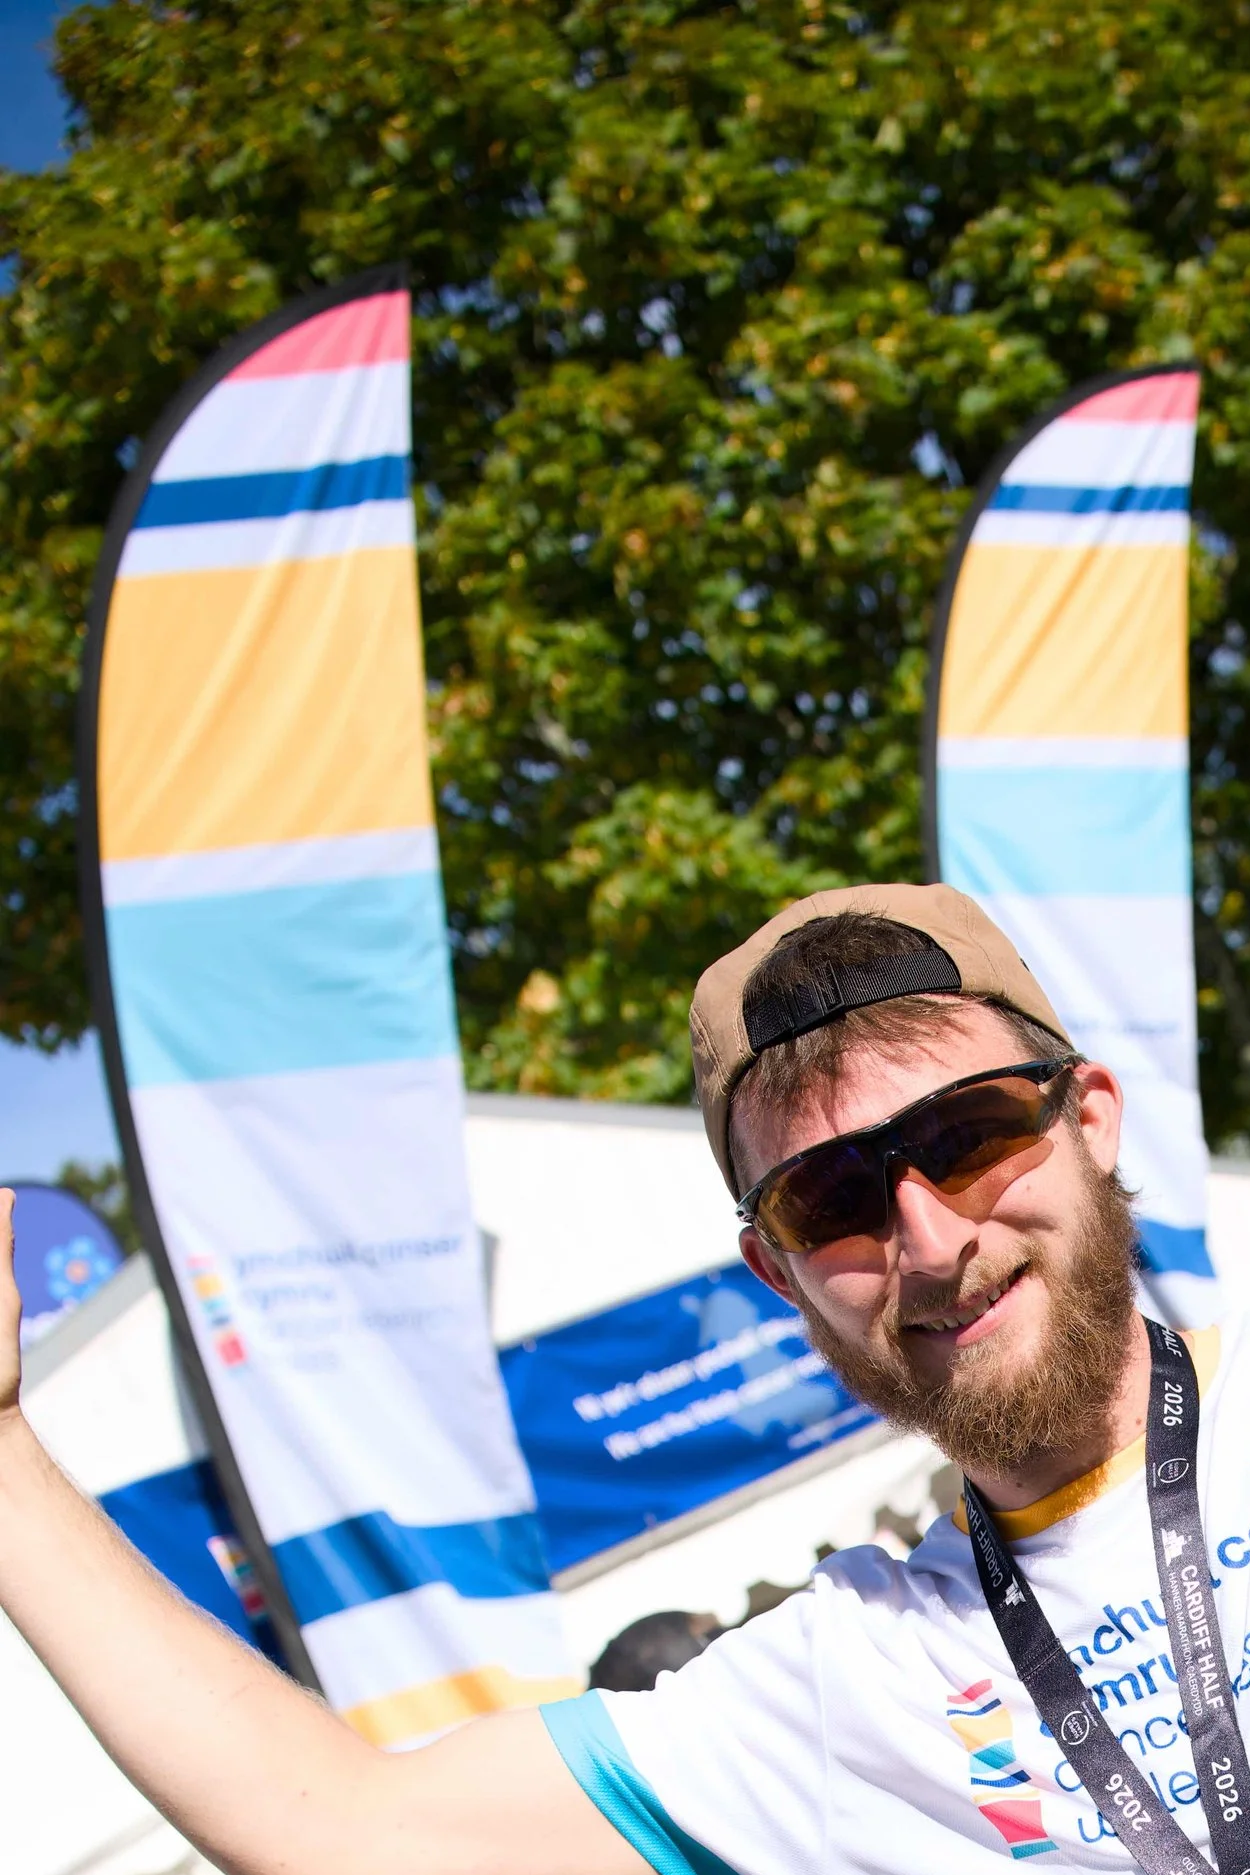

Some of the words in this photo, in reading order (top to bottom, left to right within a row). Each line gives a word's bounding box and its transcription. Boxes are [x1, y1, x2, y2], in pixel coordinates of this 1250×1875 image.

[1162, 1381, 1183, 1427] 2026
[966, 1497, 982, 1532] HAL
[976, 1529, 1004, 1588] CARDIFF
[1169, 1572, 1183, 1612] HANNER
[1176, 1611, 1194, 1665] MARATHON
[1186, 1665, 1203, 1716] CAERDYDD
[1181, 1565, 1212, 1651] CARDIFF
[1198, 1653, 1225, 1710] HALF
[1104, 1773, 1152, 1831] 2026
[1210, 1756, 1243, 1822] 2026
